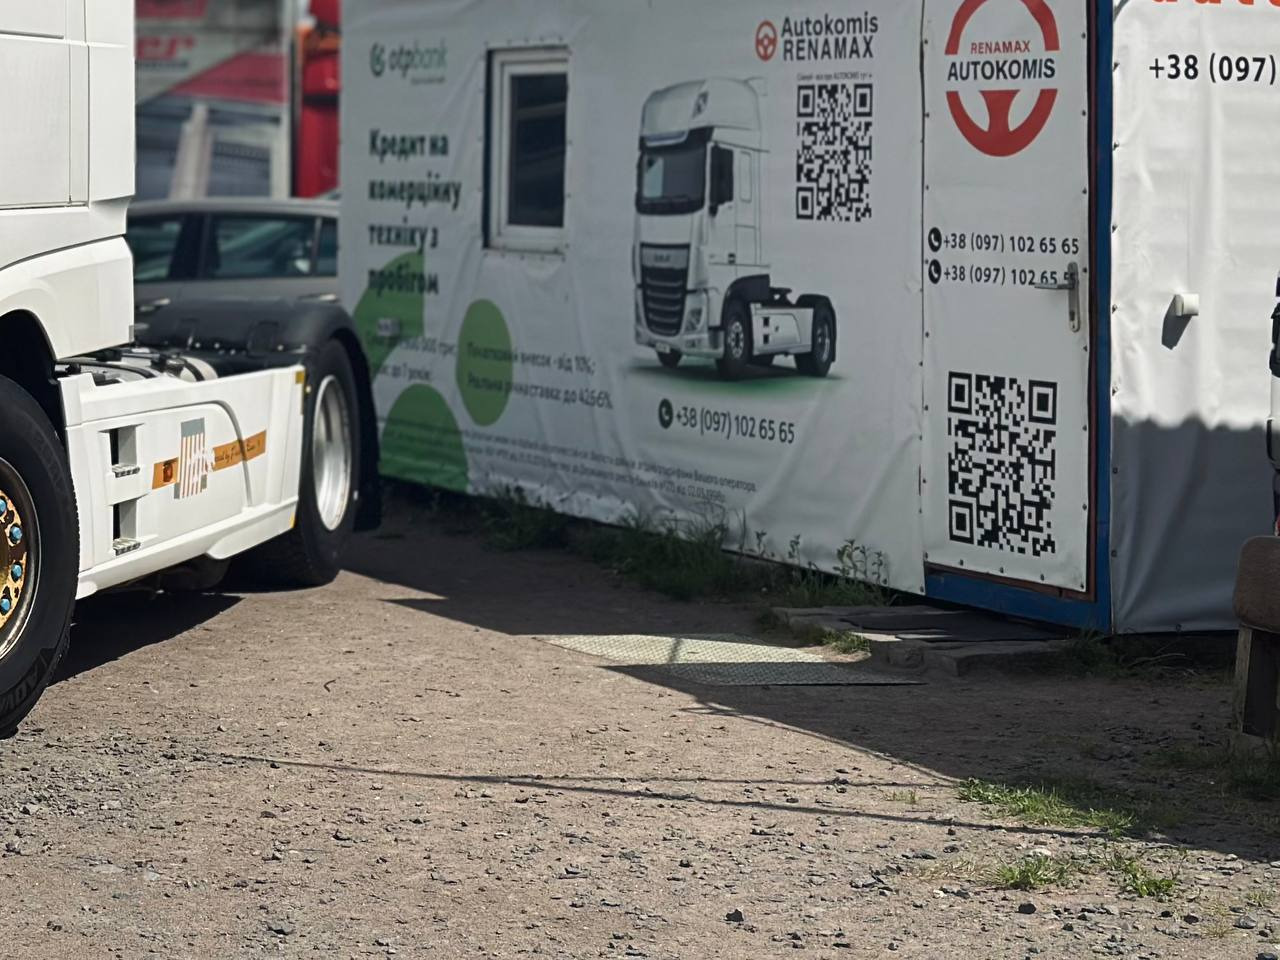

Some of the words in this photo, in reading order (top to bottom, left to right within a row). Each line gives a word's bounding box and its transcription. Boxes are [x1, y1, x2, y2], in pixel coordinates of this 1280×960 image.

[781, 11, 879, 38] Autokomis
[783, 35, 874, 61] RENAMAX
[970, 40, 1031, 54] RENAMAX
[947, 58, 1056, 81] AUTOKOMIS
[1149, 54, 1199, 80] +38
[1209, 52, 1276, 85] (097)
[369, 128, 426, 163] Кредит
[429, 134, 449, 156] на
[369, 170, 462, 211] комерційну
[369, 215, 429, 255] техніку
[944, 233, 966, 249] +38
[971, 232, 1005, 253] (097)
[1010, 236, 1035, 253] 102
[1039, 237, 1057, 253] 65
[1061, 238, 1079, 254] 65
[368, 261, 439, 297] пробігом
[944, 265, 966, 282] +38
[970, 264, 1005, 286] (097)
[1011, 269, 1035, 286] 102
[1040, 271, 1057, 286] 65
[676, 406, 697, 429] +38
[700, 407, 731, 440] (097)
[734, 415, 756, 438] 102
[759, 418, 775, 441] 65
[778, 421, 795, 444] 65
